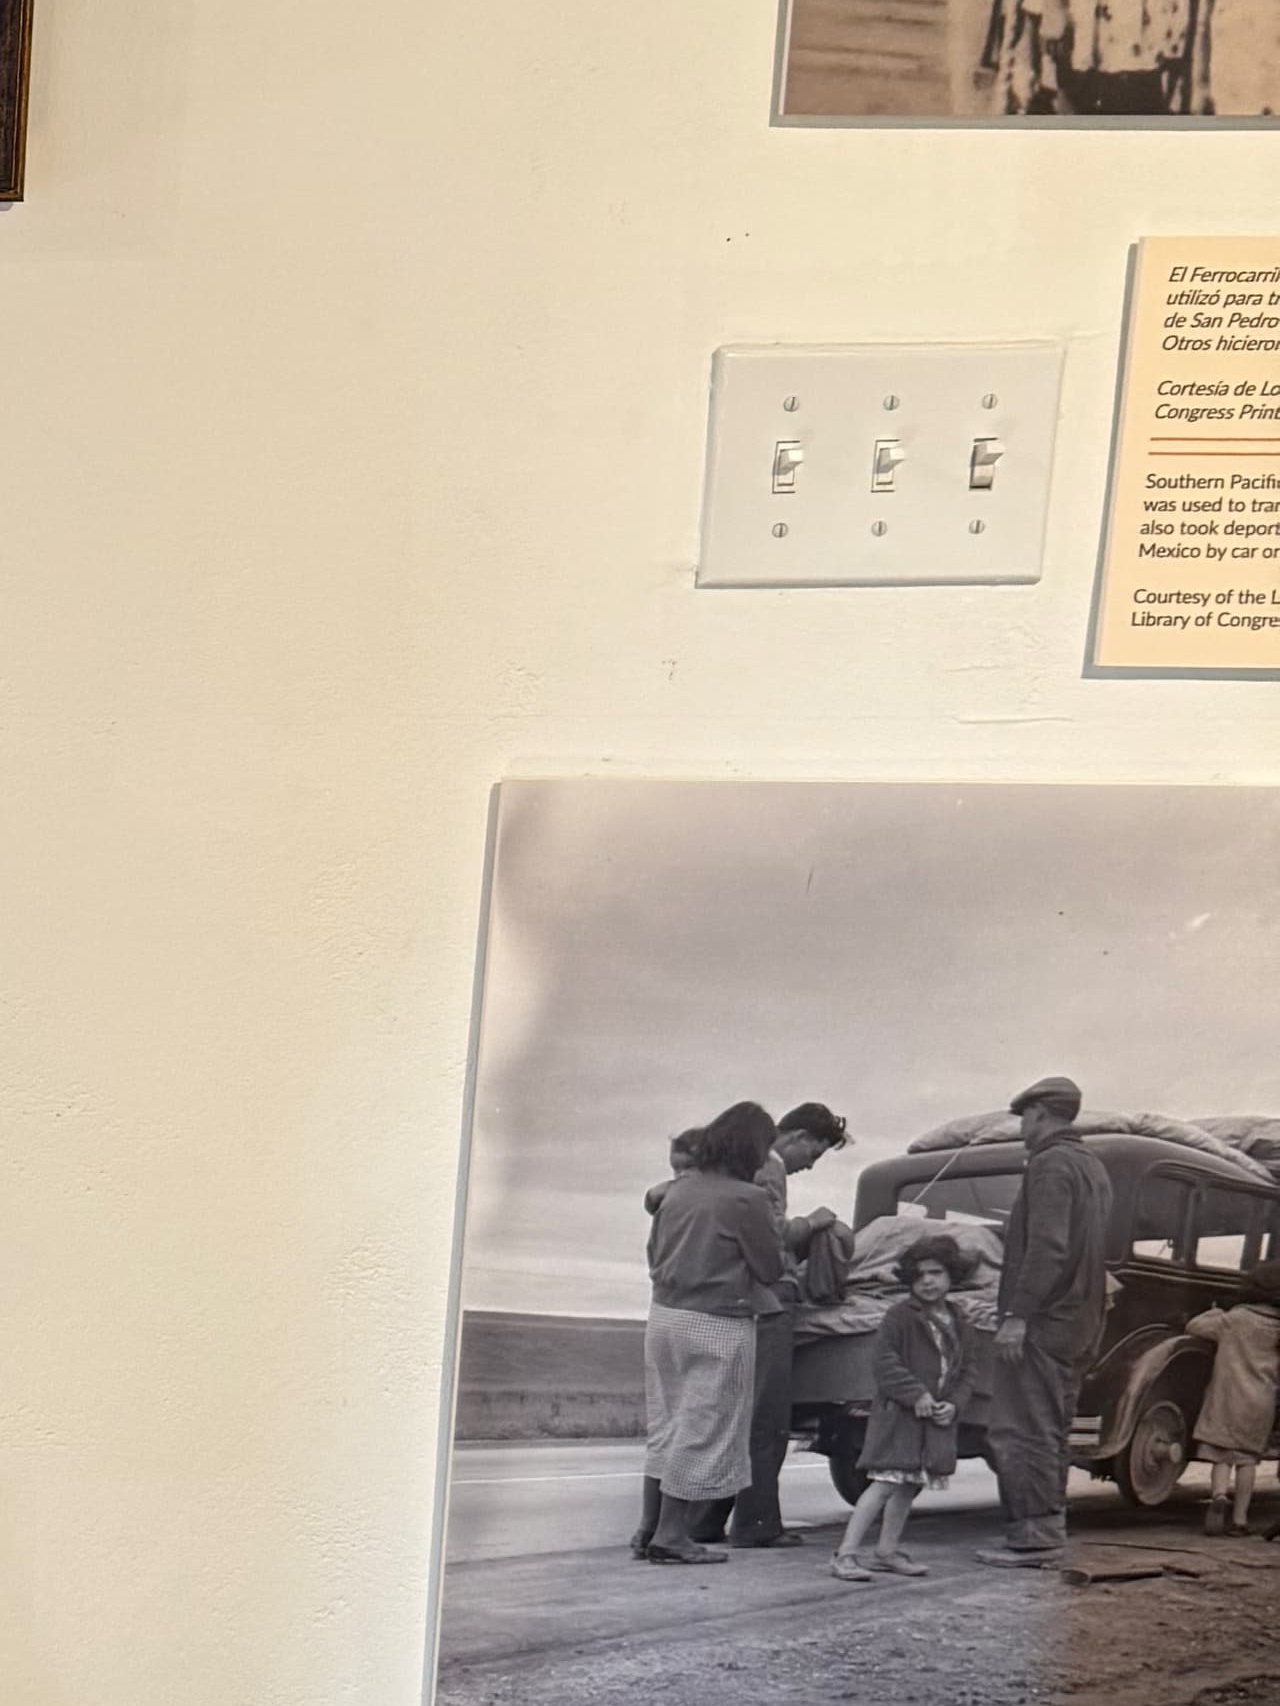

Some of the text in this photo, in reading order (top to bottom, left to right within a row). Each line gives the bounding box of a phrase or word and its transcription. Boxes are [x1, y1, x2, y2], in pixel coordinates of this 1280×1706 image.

[1168, 266, 1189, 283] El
[1166, 288, 1221, 306] utilizó
[1222, 293, 1264, 309] para
[1163, 311, 1188, 329] de
[1189, 311, 1224, 329] San
[1162, 334, 1213, 351] Otros
[1156, 380, 1230, 397] Cortesía
[1233, 380, 1257, 397] de
[1154, 403, 1236, 423] Congress
[1145, 473, 1225, 490] Southern
[1143, 500, 1177, 512] was
[1181, 496, 1223, 513] used
[1228, 498, 1246, 513] to
[1139, 519, 1175, 536] also
[1180, 519, 1220, 536] took
[1138, 542, 1202, 559] Mexico
[1205, 543, 1228, 562] by
[1231, 547, 1259, 559] car
[1133, 588, 1212, 608] Courtesy
[1214, 588, 1235, 605] of
[1238, 589, 1267, 605] the
[1131, 611, 1191, 630] Library
[1194, 611, 1214, 627] of
